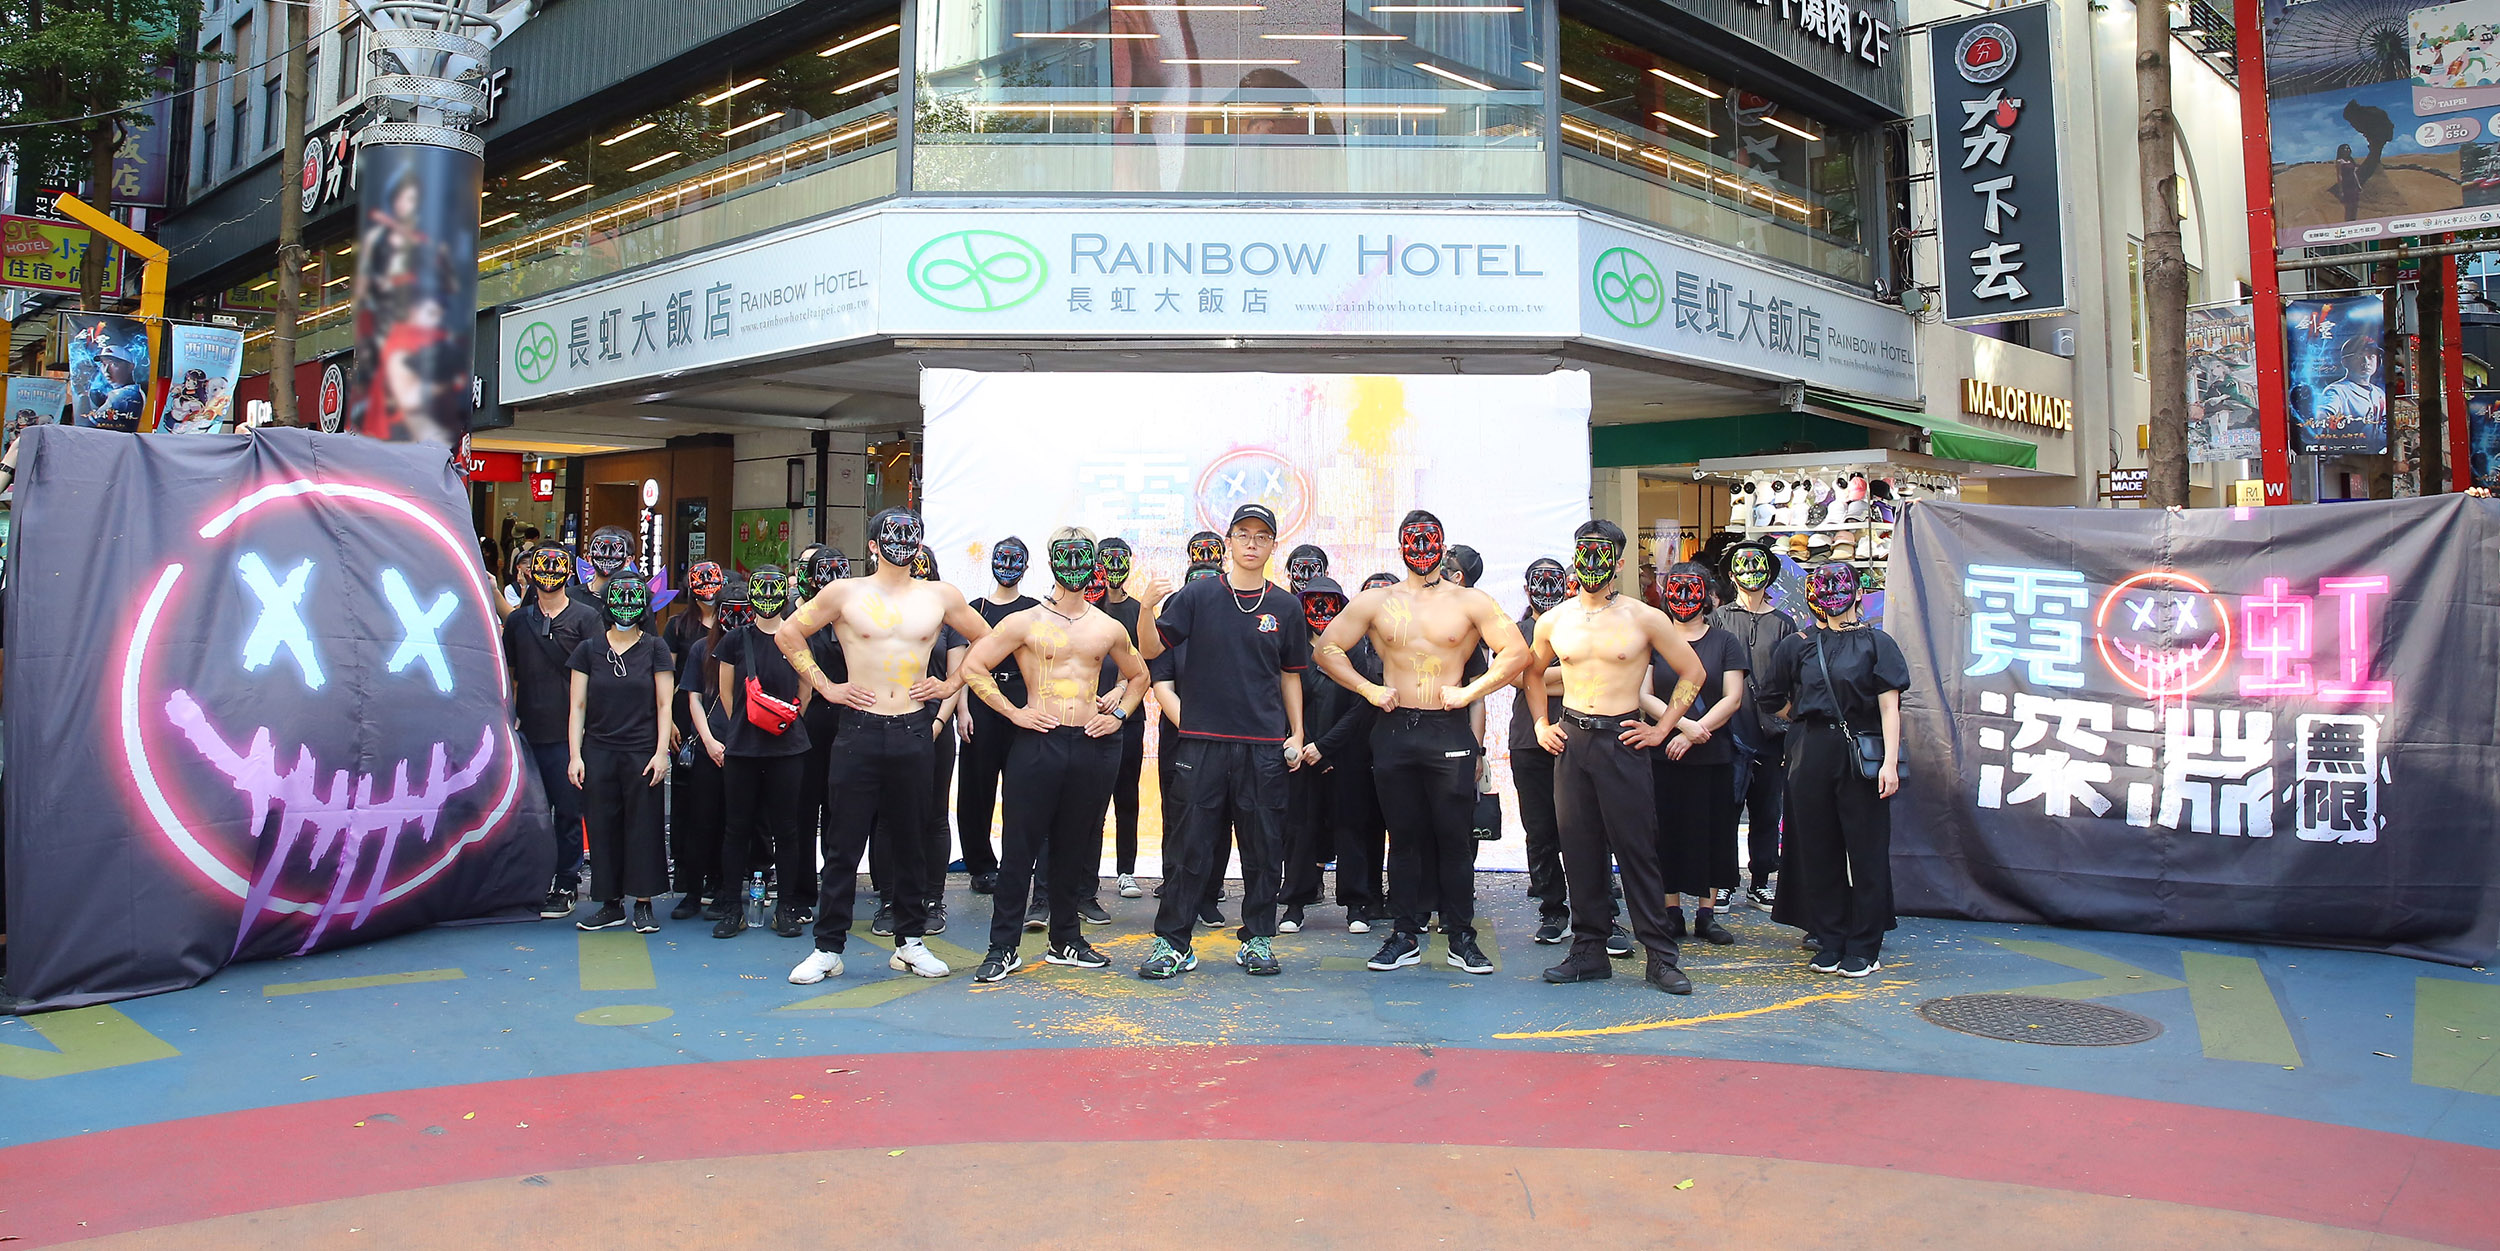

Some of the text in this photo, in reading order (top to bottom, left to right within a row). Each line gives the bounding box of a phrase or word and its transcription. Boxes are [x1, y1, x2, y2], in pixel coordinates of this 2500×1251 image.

[1859, 10, 1891, 68] 2F
[2438, 98, 2467, 108] TAIPEI
[2424, 126, 2435, 138] 2
[2446, 130, 2468, 139] 650
[1960, 88, 2029, 301] 夯下去
[4, 221, 39, 240] 9F
[6, 240, 49, 254] HOTEL
[1069, 232, 1544, 277] RAINBOW HOTEL
[9, 260, 53, 281] 住宿
[2398, 269, 2418, 279] 2F
[741, 269, 869, 314] RAINBOW HOTEL
[1066, 286, 1269, 314] 長虹大飯店
[740, 299, 869, 335] www.rainbowhoteltaipei.com.tw
[1295, 301, 1544, 316] www.rainbowhoteltaipei.com.tw
[1671, 269, 1822, 362] 長虹大飯店
[567, 280, 733, 370] 長虹大飯店
[1828, 327, 1914, 365] RAINBOW HOTEL
[1968, 379, 2073, 432] MAJOR MADE
[2111, 471, 2148, 481] MAJOR
[2111, 482, 2142, 491] MADE
[2266, 483, 2283, 496] W
[1963, 563, 2393, 702] 霓 虹
[1977, 690, 2274, 838] 深淵
[2303, 719, 2369, 831] 無限
